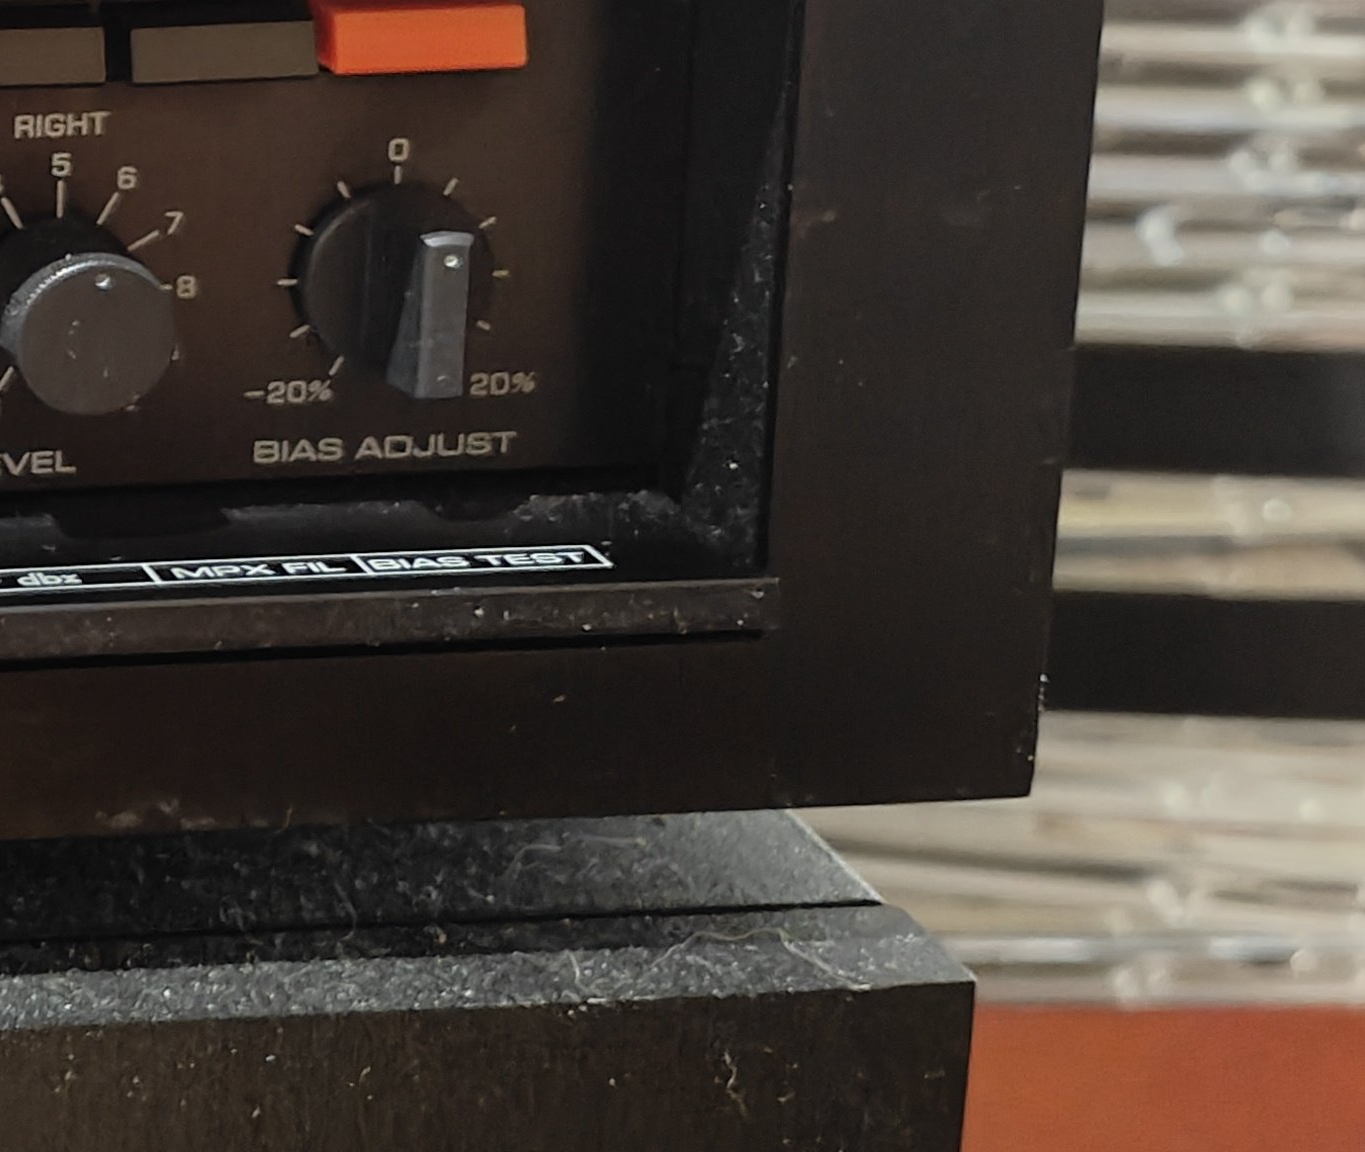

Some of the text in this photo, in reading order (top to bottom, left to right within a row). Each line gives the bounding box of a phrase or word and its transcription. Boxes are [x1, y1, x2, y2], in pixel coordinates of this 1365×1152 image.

[13, 110, 110, 139] RIGHT
[388, 138, 409, 163] 0
[51, 153, 72, 177] 5
[116, 166, 138, 190] 6
[165, 211, 187, 235] 7
[175, 276, 197, 300] 8
[244, 378, 332, 404] -20%
[253, 431, 517, 464] BIAS ADJUST
[170, 560, 346, 580] MPX FIL
[369, 550, 584, 571] BIAS TEST
[18, 570, 82, 587] dbx
